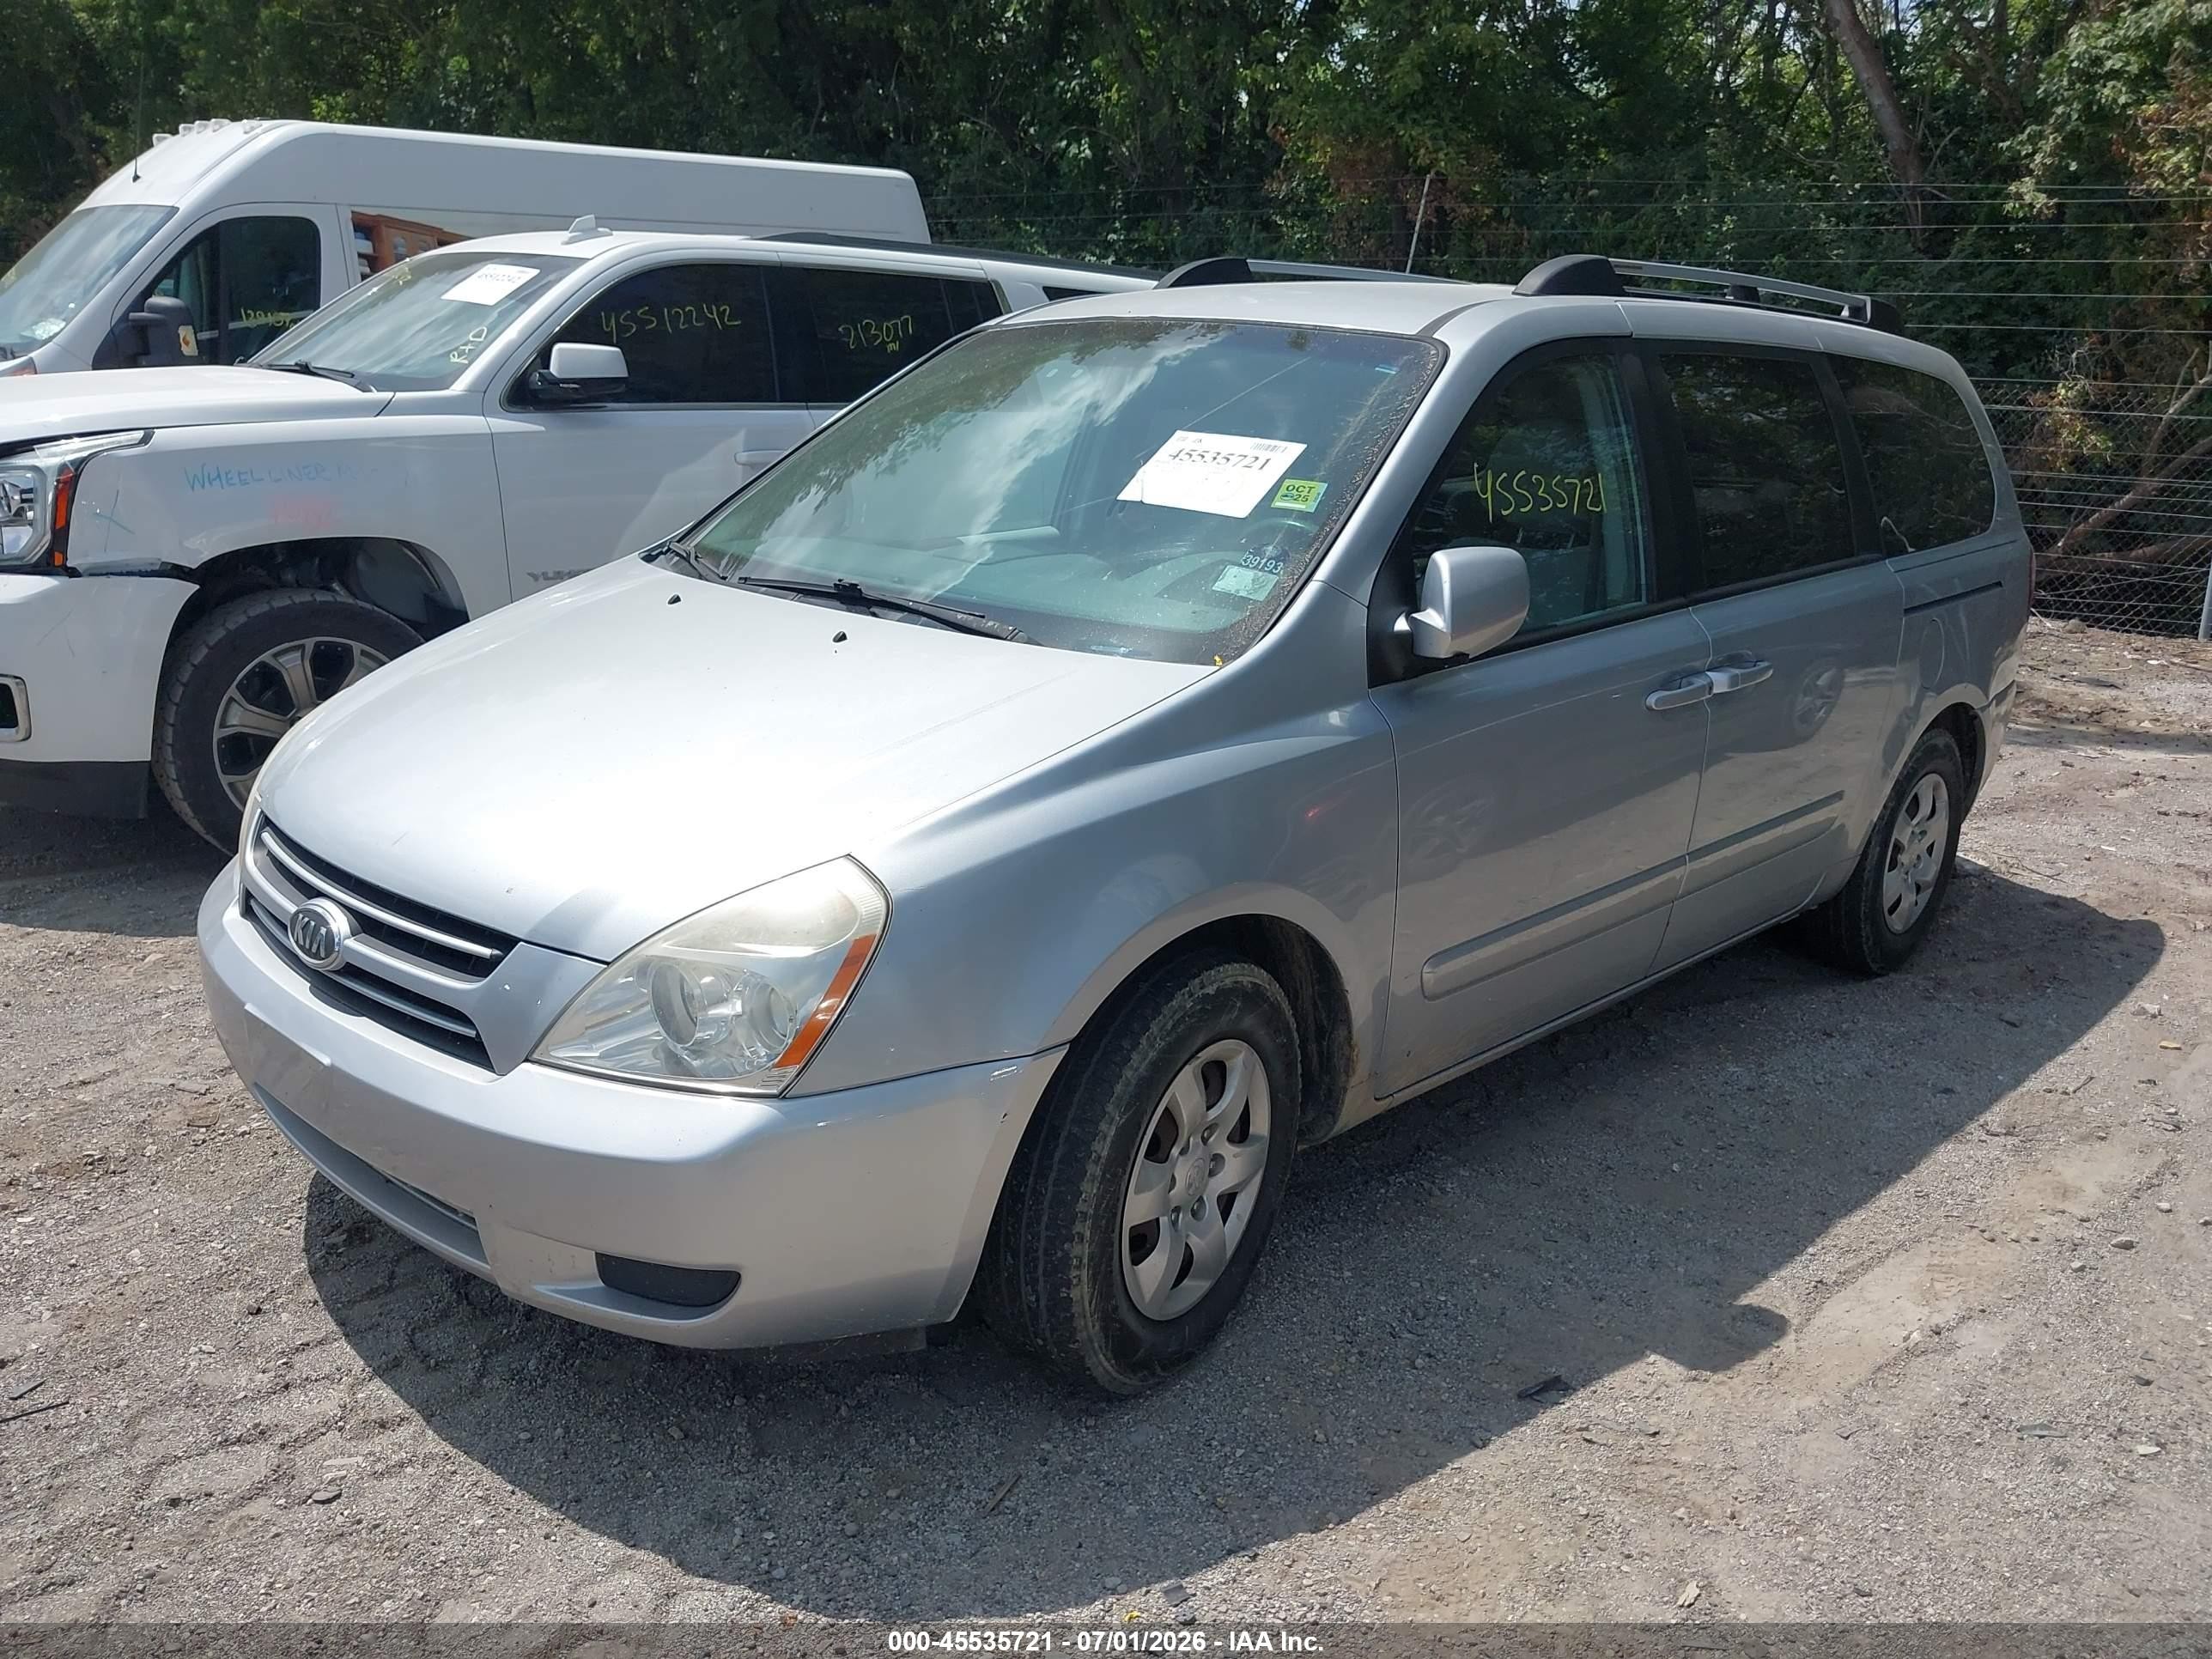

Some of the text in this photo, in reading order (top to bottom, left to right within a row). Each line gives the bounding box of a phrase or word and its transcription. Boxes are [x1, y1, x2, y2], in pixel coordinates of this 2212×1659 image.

[600, 304, 742, 344] 45512242
[837, 315, 913, 349] 213077
[1169, 447, 1272, 471] 45535721
[184, 462, 264, 492] WHEEL
[1285, 484, 1316, 495] OCT
[1474, 462, 1607, 524] 45535721
[1294, 494, 1310, 502] 25
[294, 913, 327, 958] KIA
